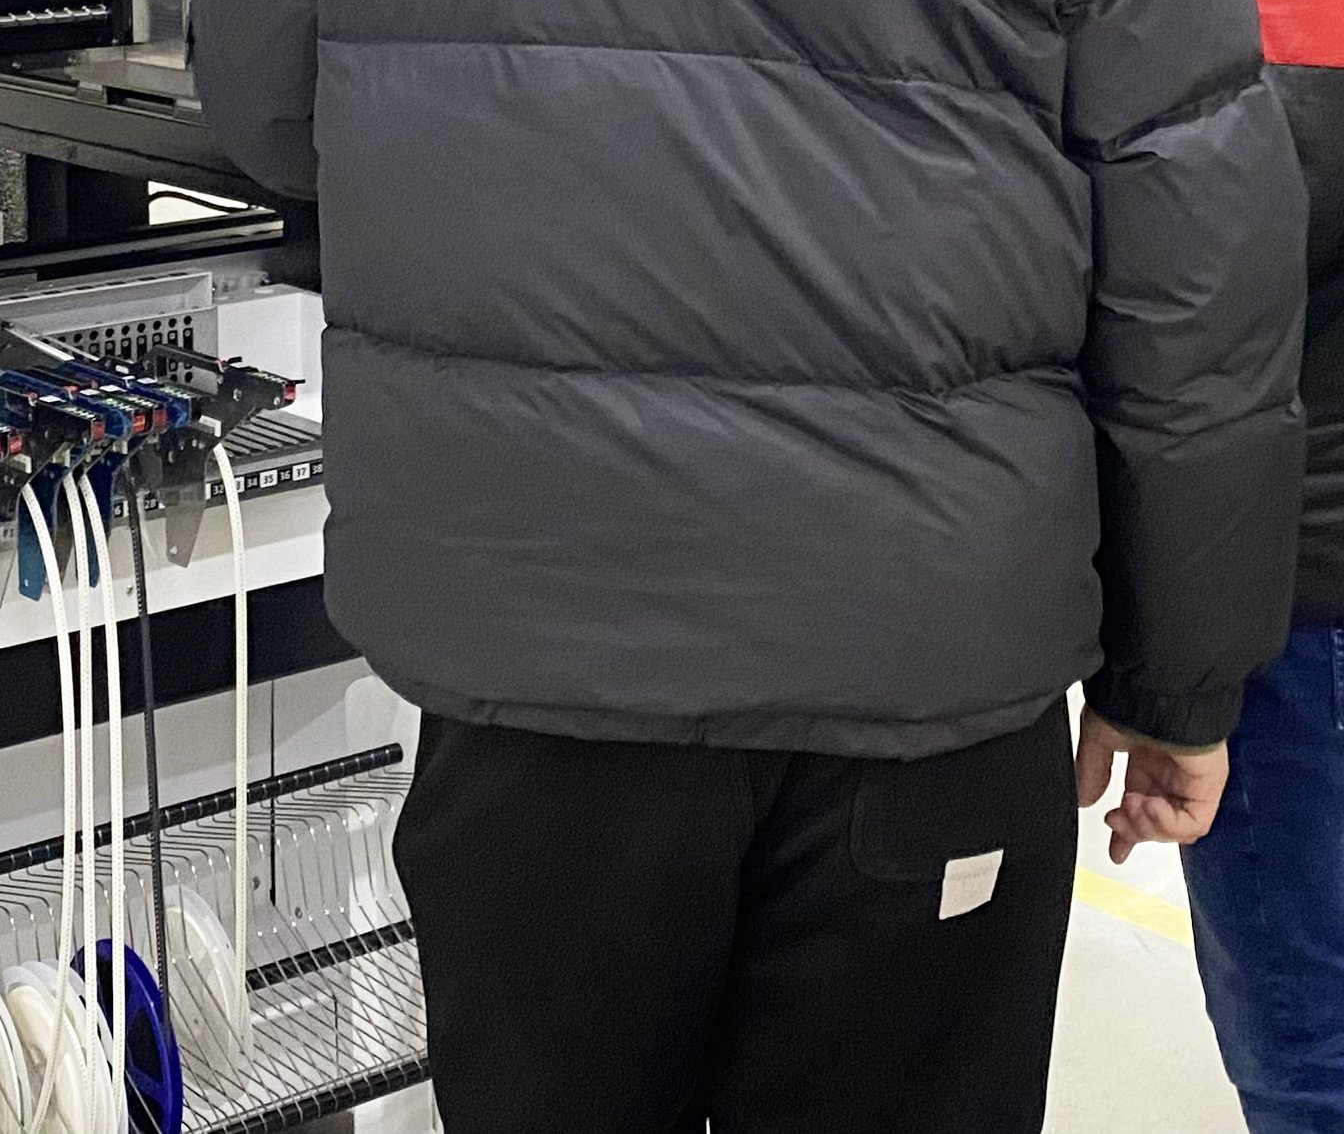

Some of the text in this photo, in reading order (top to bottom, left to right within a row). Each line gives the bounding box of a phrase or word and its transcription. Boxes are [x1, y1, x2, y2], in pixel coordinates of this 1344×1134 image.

[213, 484, 225, 495] 32
[263, 474, 274, 484] 35
[279, 470, 291, 481] 36
[296, 467, 307, 477] 37
